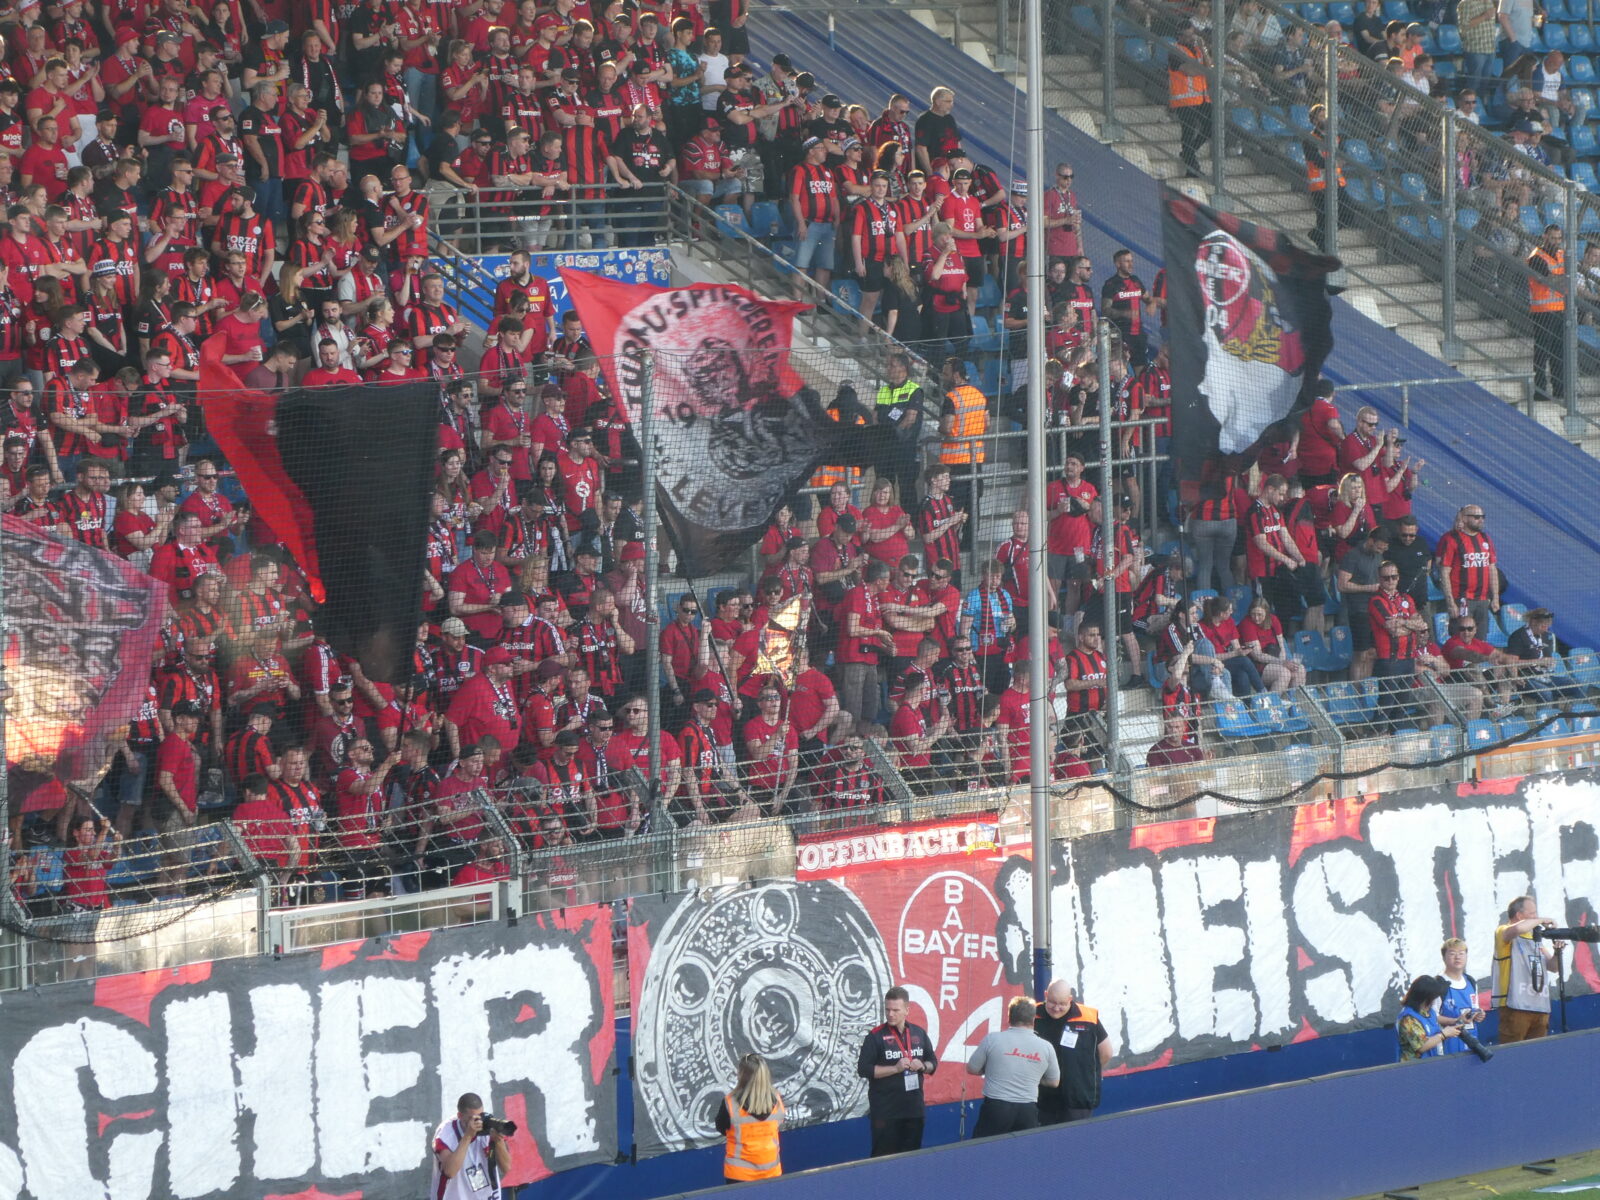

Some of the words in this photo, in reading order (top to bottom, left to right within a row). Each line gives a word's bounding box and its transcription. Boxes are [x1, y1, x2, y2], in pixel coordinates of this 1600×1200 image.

[1205, 304, 1230, 330] 04
[800, 828, 960, 871] OFFENBACH
[904, 929, 1000, 962] BAYER
[1519, 982, 1549, 998] FOO
[0, 941, 601, 1200] CHER
